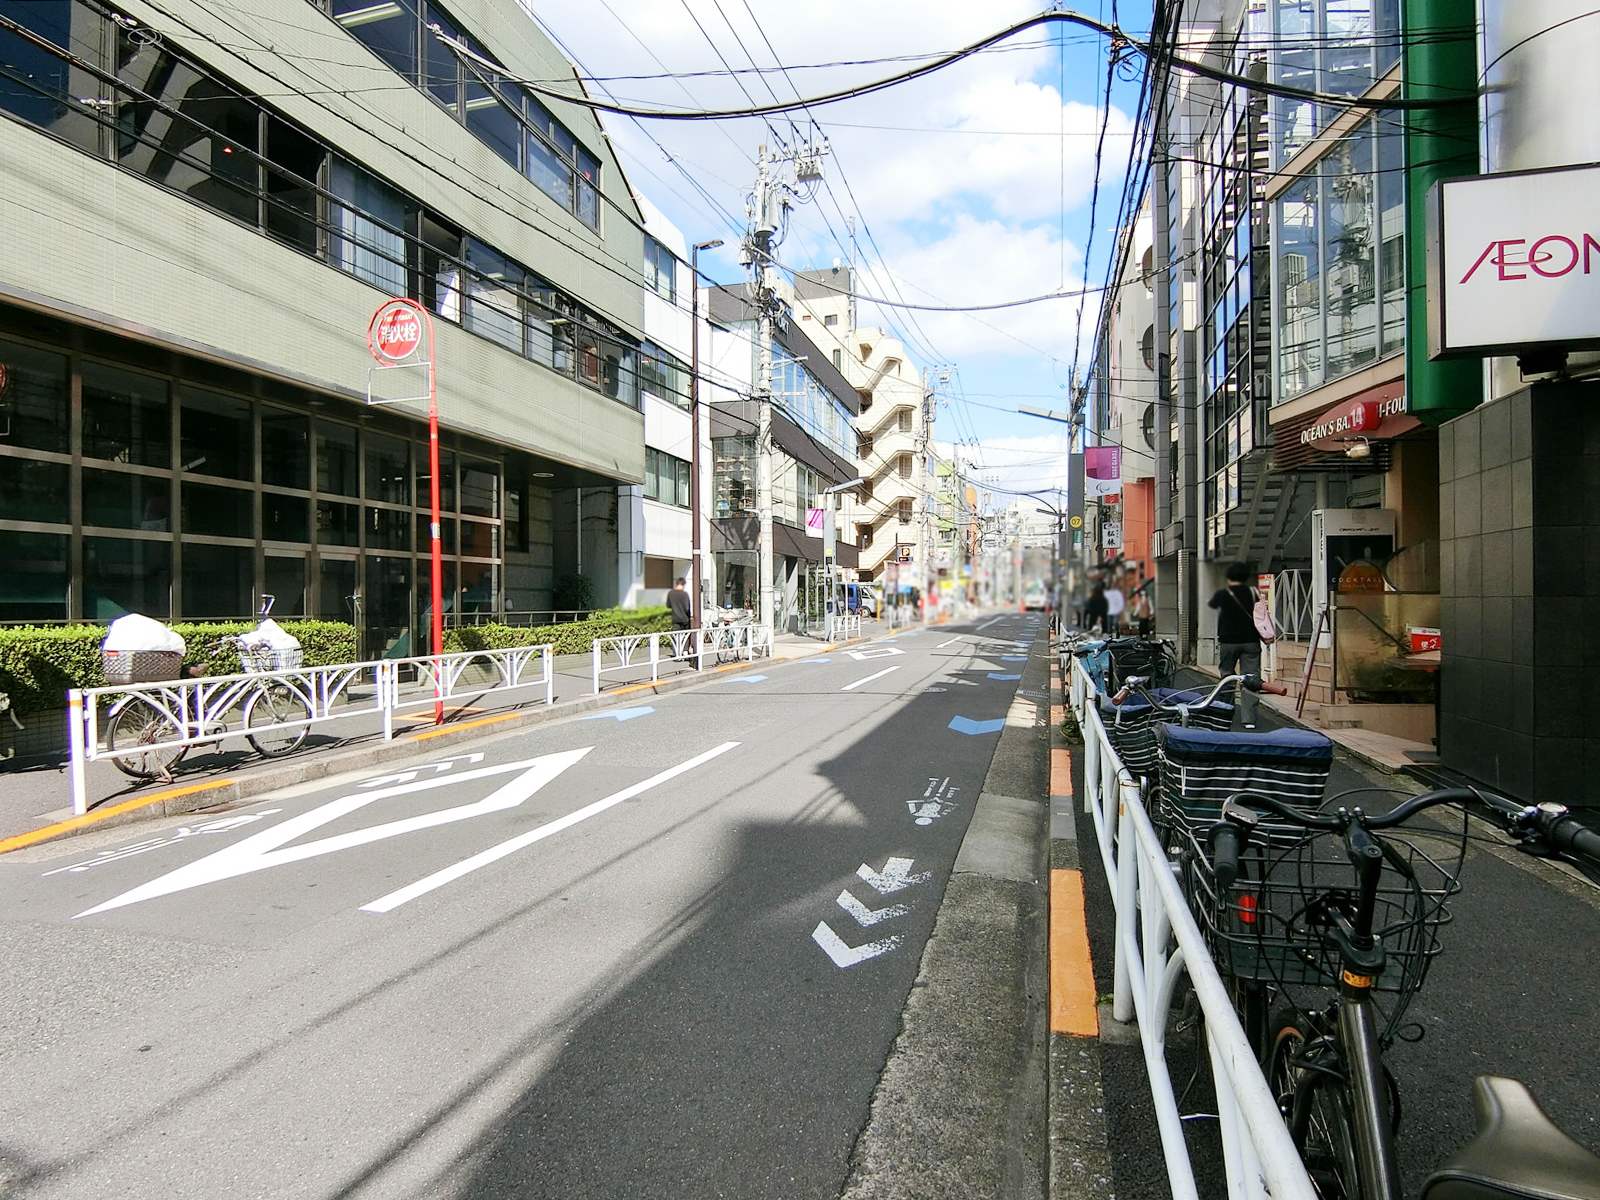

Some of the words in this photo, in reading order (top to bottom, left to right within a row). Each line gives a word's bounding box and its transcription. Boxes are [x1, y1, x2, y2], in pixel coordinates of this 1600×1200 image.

[381, 322, 417, 344] 消火栓
[1350, 406, 1363, 427] 14
[1301, 420, 1334, 444] OCEAN'S
[1336, 415, 1351, 433] BA
[902, 548, 909, 556] P
